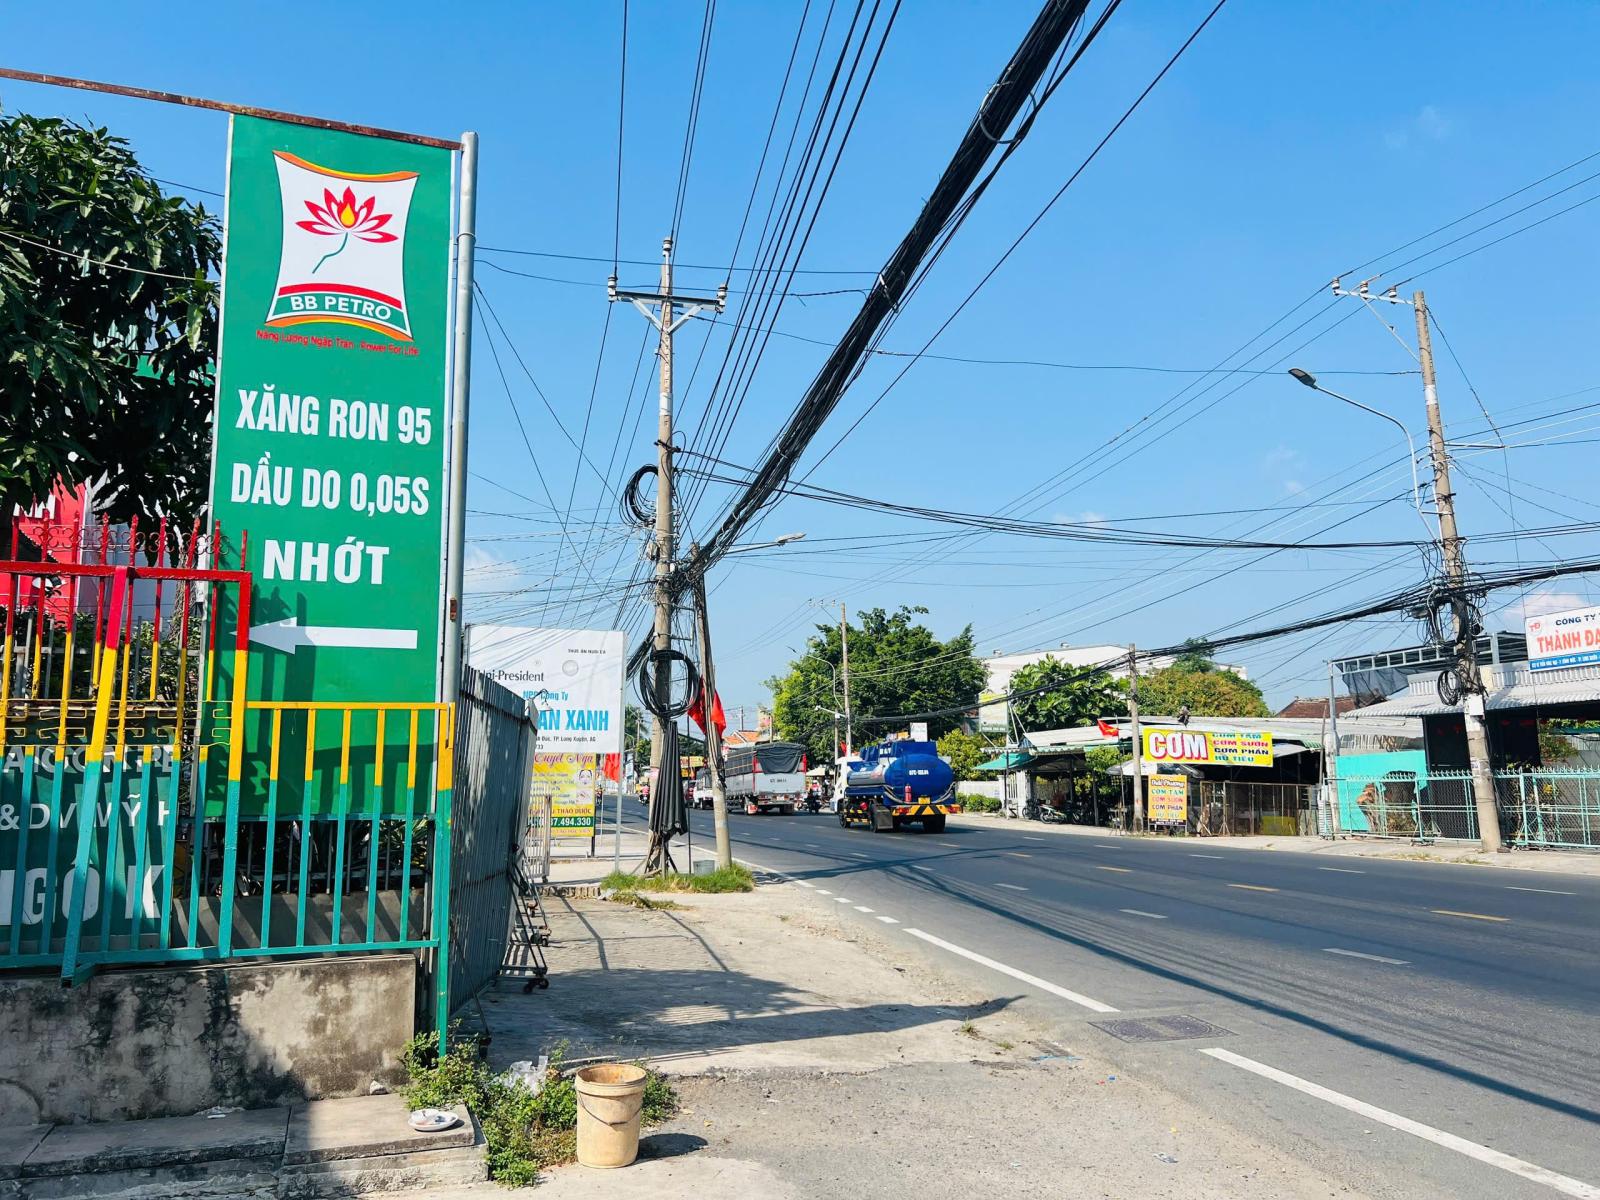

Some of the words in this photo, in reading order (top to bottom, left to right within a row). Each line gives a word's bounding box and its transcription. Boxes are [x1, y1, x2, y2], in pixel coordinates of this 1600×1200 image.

[290, 295, 318, 311] BB
[324, 295, 392, 320] PETRO
[360, 341, 386, 352] Power
[388, 344, 402, 354] For
[403, 346, 419, 356] Life
[235, 383, 320, 436] XĂNG
[328, 398, 389, 441] RON
[397, 405, 432, 445] 95
[231, 451, 293, 506] DẦU
[301, 468, 341, 509] DO
[350, 472, 429, 517] 0,05S
[262, 535, 390, 585] NHỚT
[1536, 629, 1581, 653] THÀNH
[484, 669, 544, 682] ni-President
[561, 691, 569, 701] Ty
[565, 710, 609, 731] XANH
